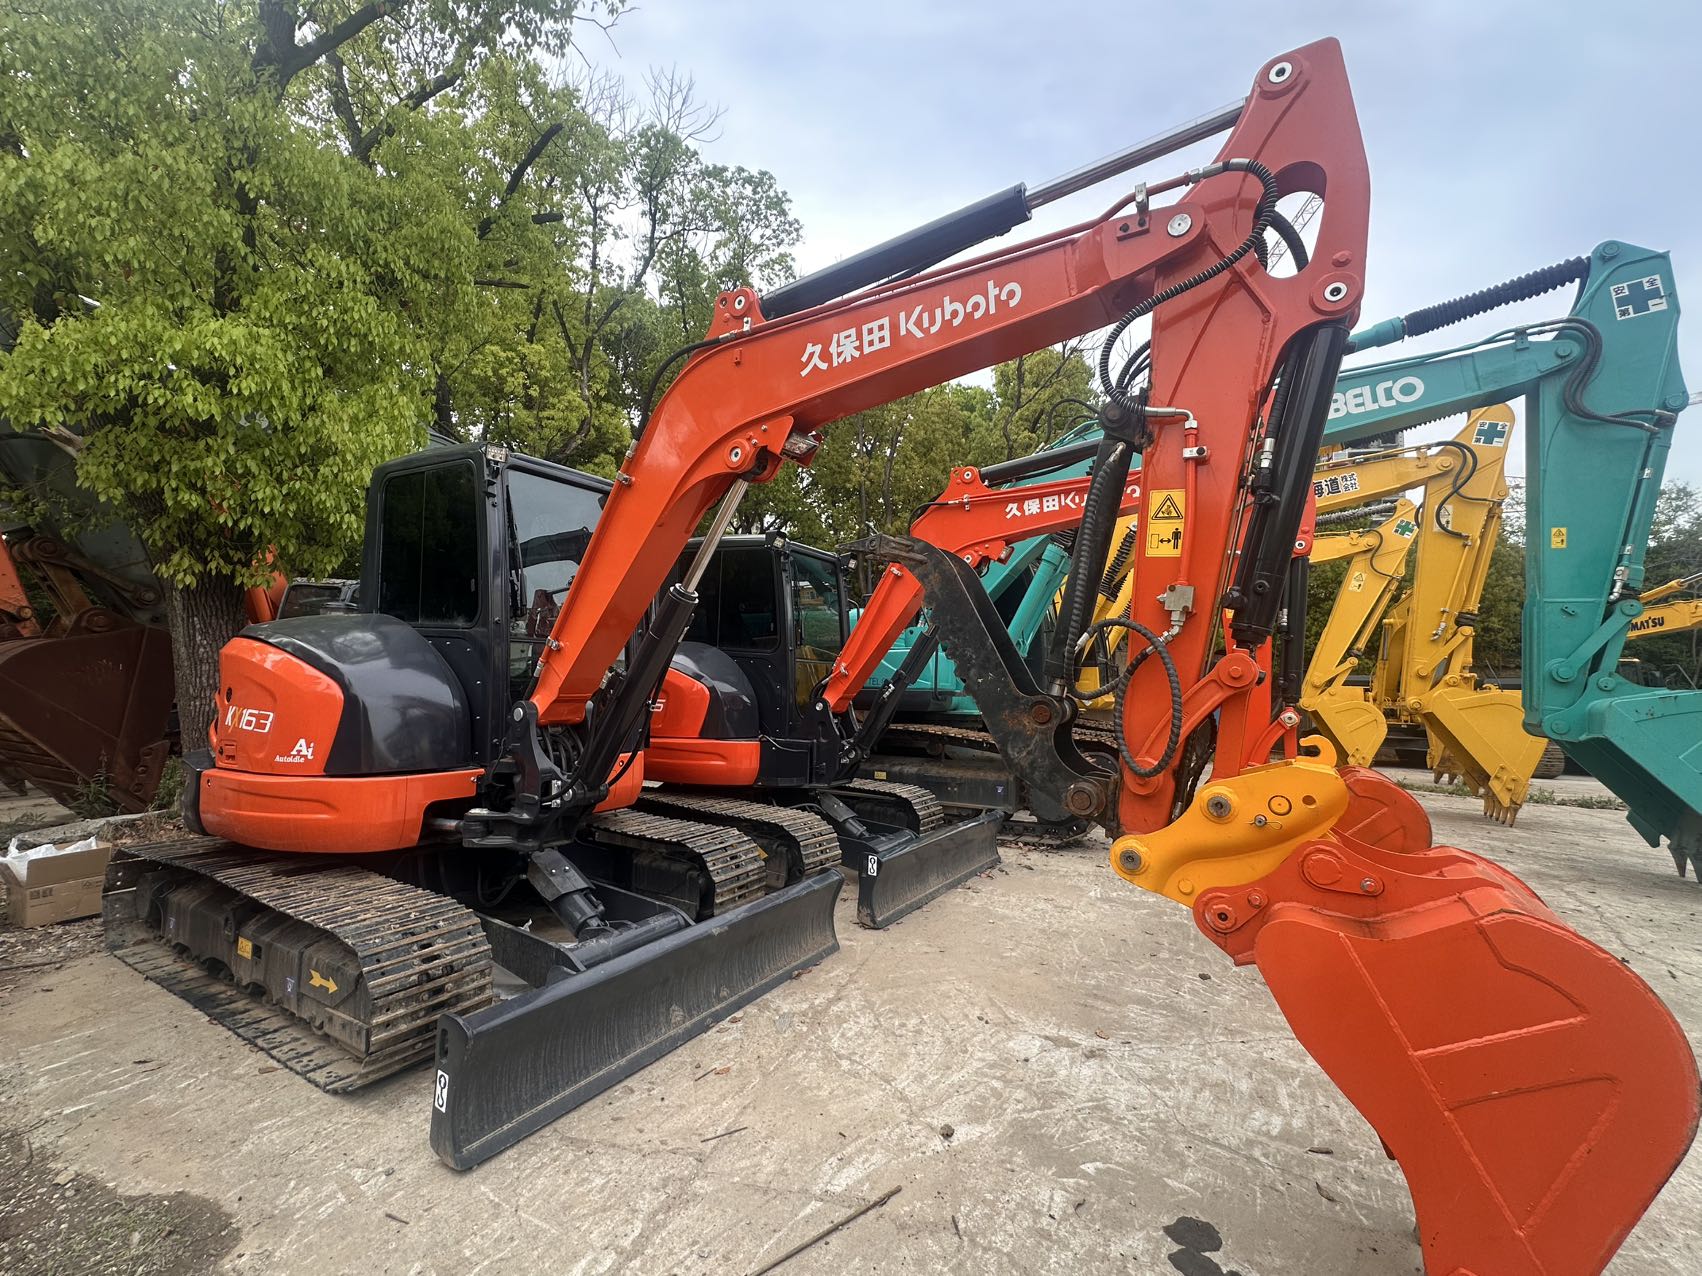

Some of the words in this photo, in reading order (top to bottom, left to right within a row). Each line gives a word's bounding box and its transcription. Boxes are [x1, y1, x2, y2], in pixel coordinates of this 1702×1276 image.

[800, 316, 891, 378] 久保田
[899, 279, 1022, 339] Kubota
[1005, 494, 1060, 519] 久保田
[225, 705, 274, 733] KX163
[290, 738, 314, 760] Ai
